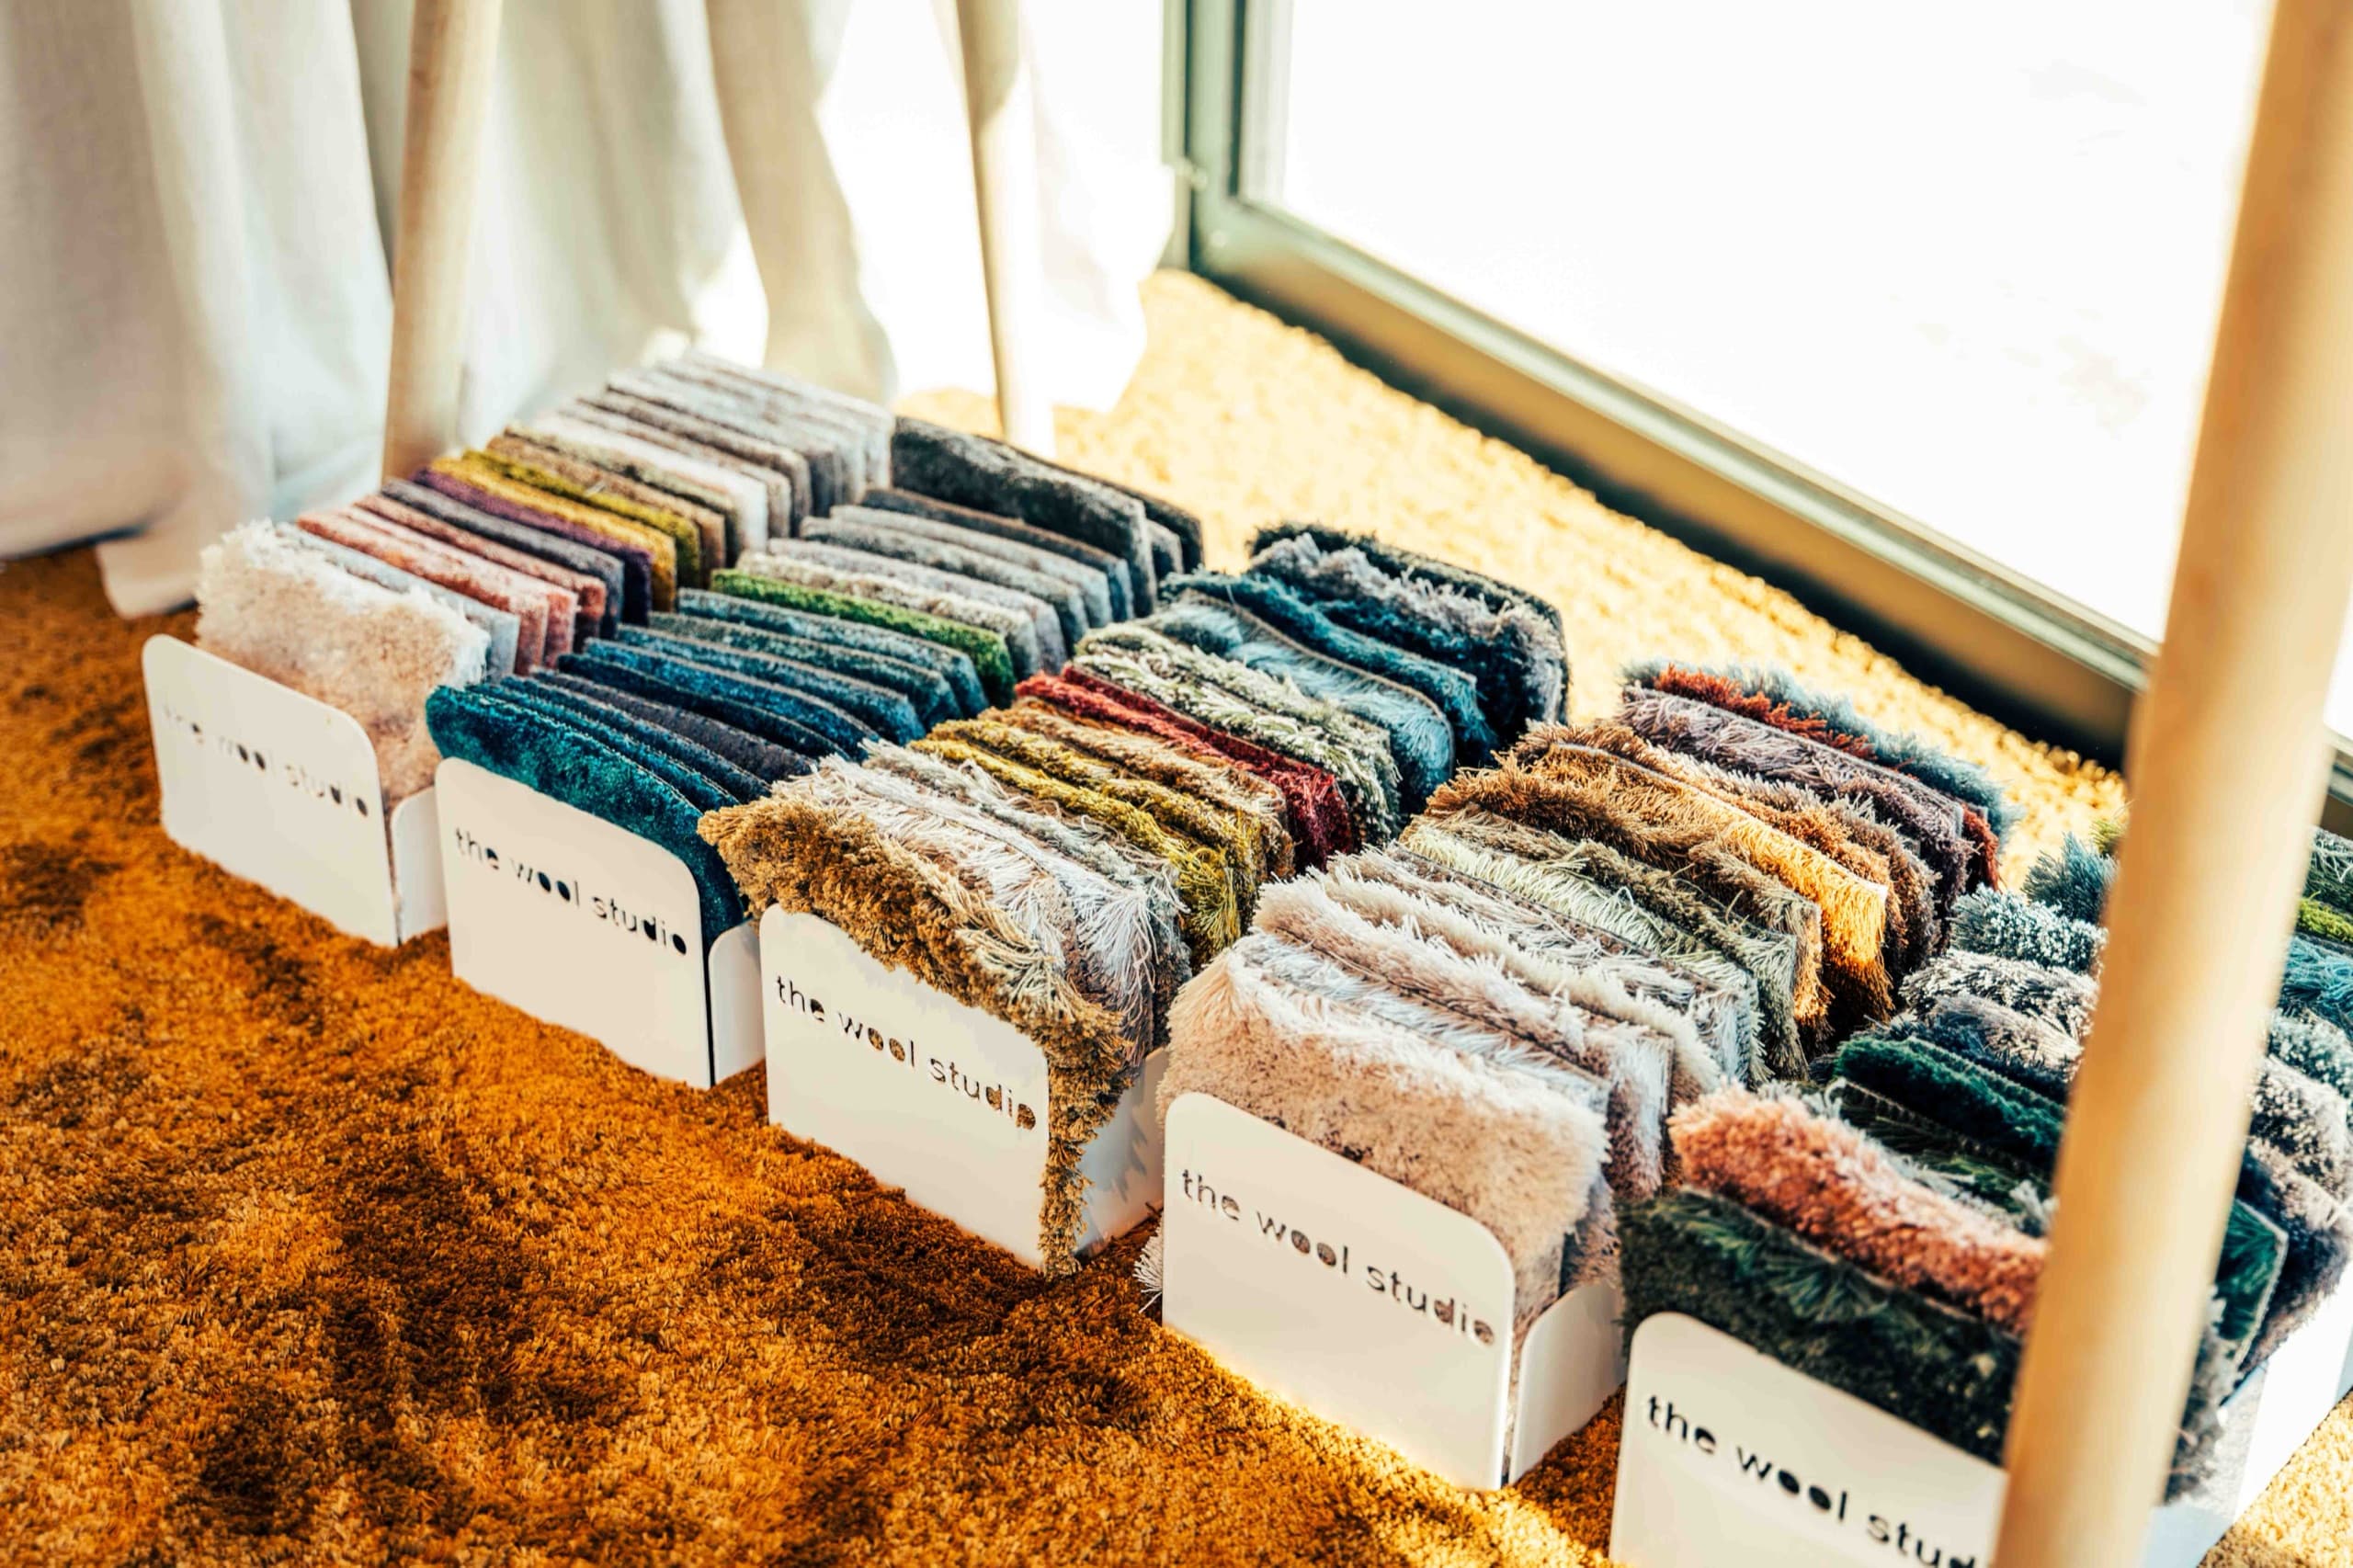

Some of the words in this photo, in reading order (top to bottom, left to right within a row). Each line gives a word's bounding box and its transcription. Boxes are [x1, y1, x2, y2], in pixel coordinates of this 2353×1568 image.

[455, 827, 500, 870] the
[509, 856, 580, 906] wool
[591, 892, 688, 955] studio
[777, 975, 825, 1023] the
[837, 1012, 915, 1068] wool
[929, 1057, 1037, 1131] studio
[1182, 1168, 1241, 1221] the
[1256, 1210, 1349, 1275] wool
[1366, 1265, 1495, 1346] studio
[1648, 1395, 1717, 1455] the
[1735, 1446, 1847, 1524] wool
